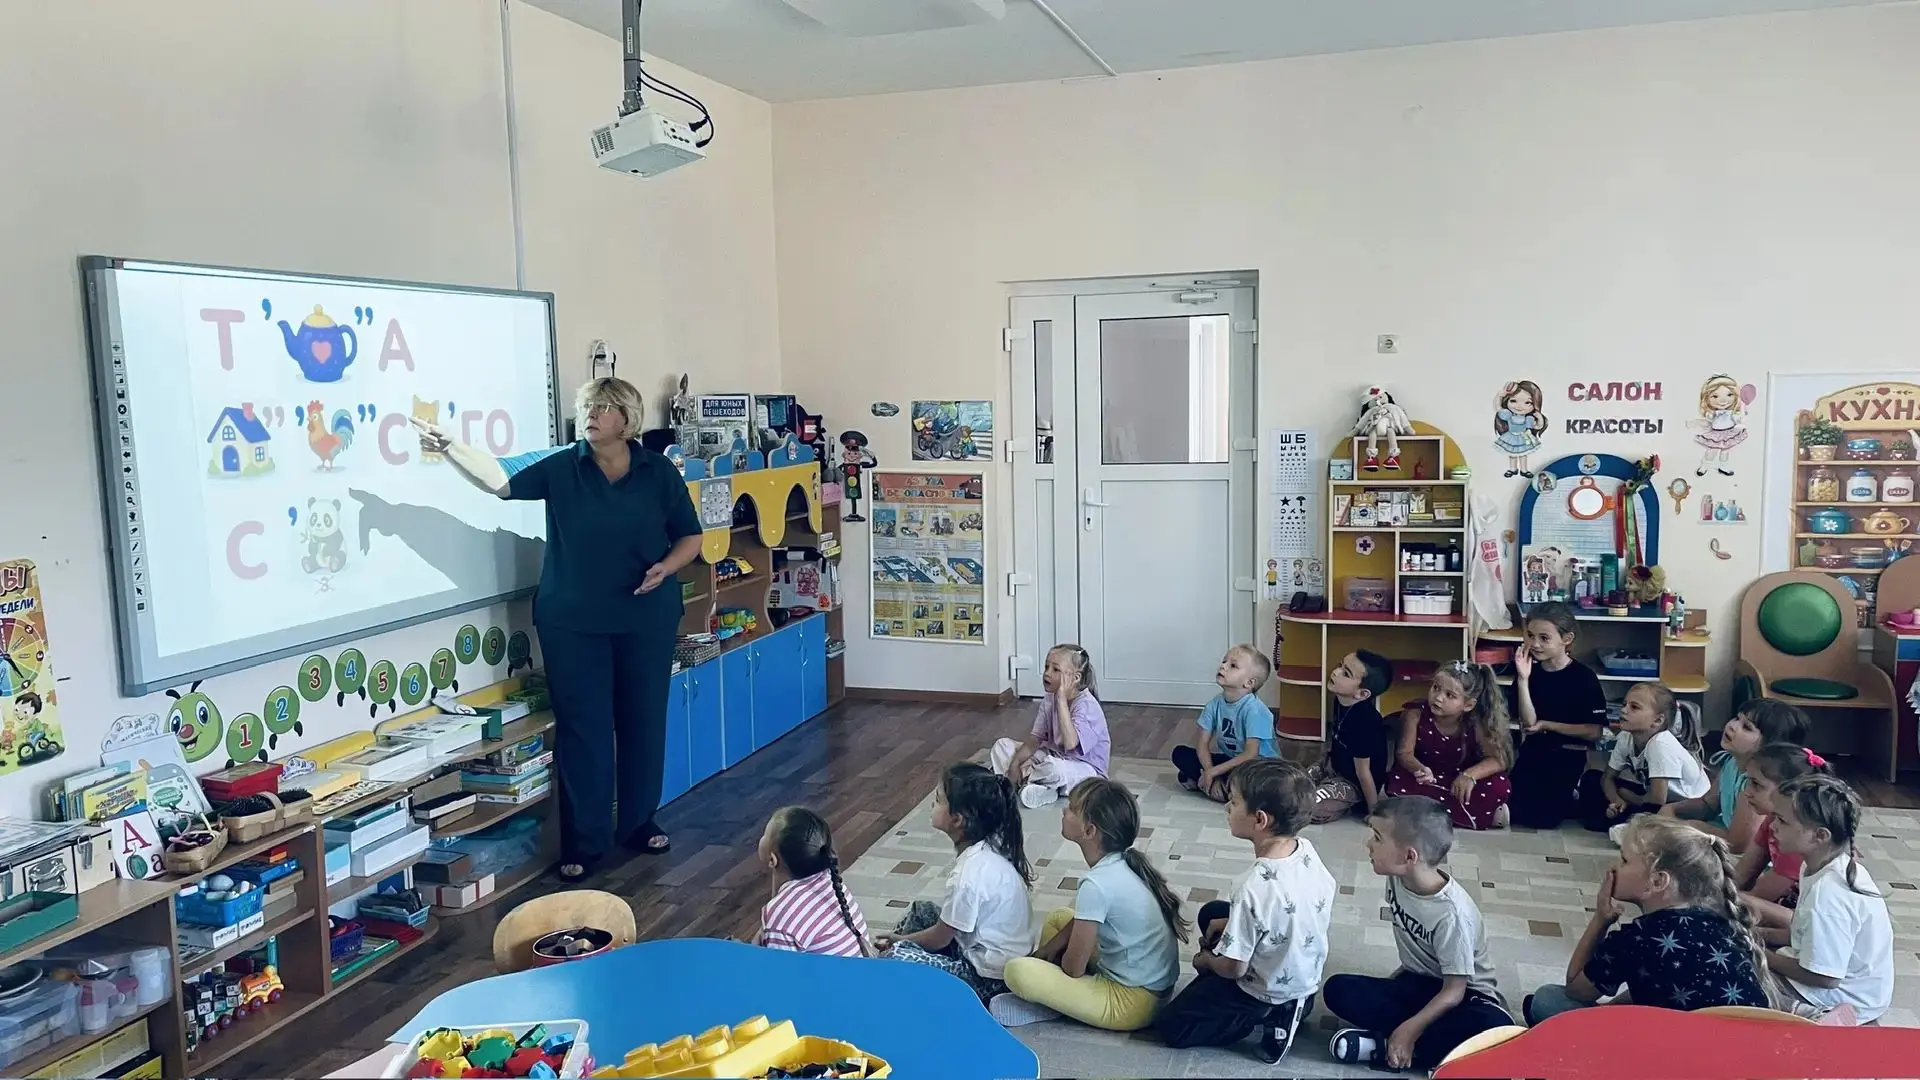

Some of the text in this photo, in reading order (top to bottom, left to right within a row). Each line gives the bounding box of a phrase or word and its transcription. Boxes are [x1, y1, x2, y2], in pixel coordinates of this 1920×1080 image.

[200, 308, 415, 372] Т А
[1568, 382, 1662, 401] САЛОН
[703, 408, 746, 416] ПЕШЕХОДОВ
[705, 400, 743, 408] ДЛЯ ЮНЫХ
[1566, 419, 1663, 434] КРАСОТЫ
[378, 413, 409, 465] С
[226, 520, 268, 580] С
[0, 565, 26, 594] Ы
[463, 635, 474, 655] 8
[491, 636, 498, 657] 9
[309, 667, 322, 690] 3
[345, 658, 357, 680] 4
[438, 658, 449, 679] 7
[378, 671, 388, 693] 5
[408, 675, 421, 696] 6
[276, 697, 289, 721] 2
[240, 723, 252, 748] 1
[123, 819, 152, 854] А
[151, 853, 166, 873] а
